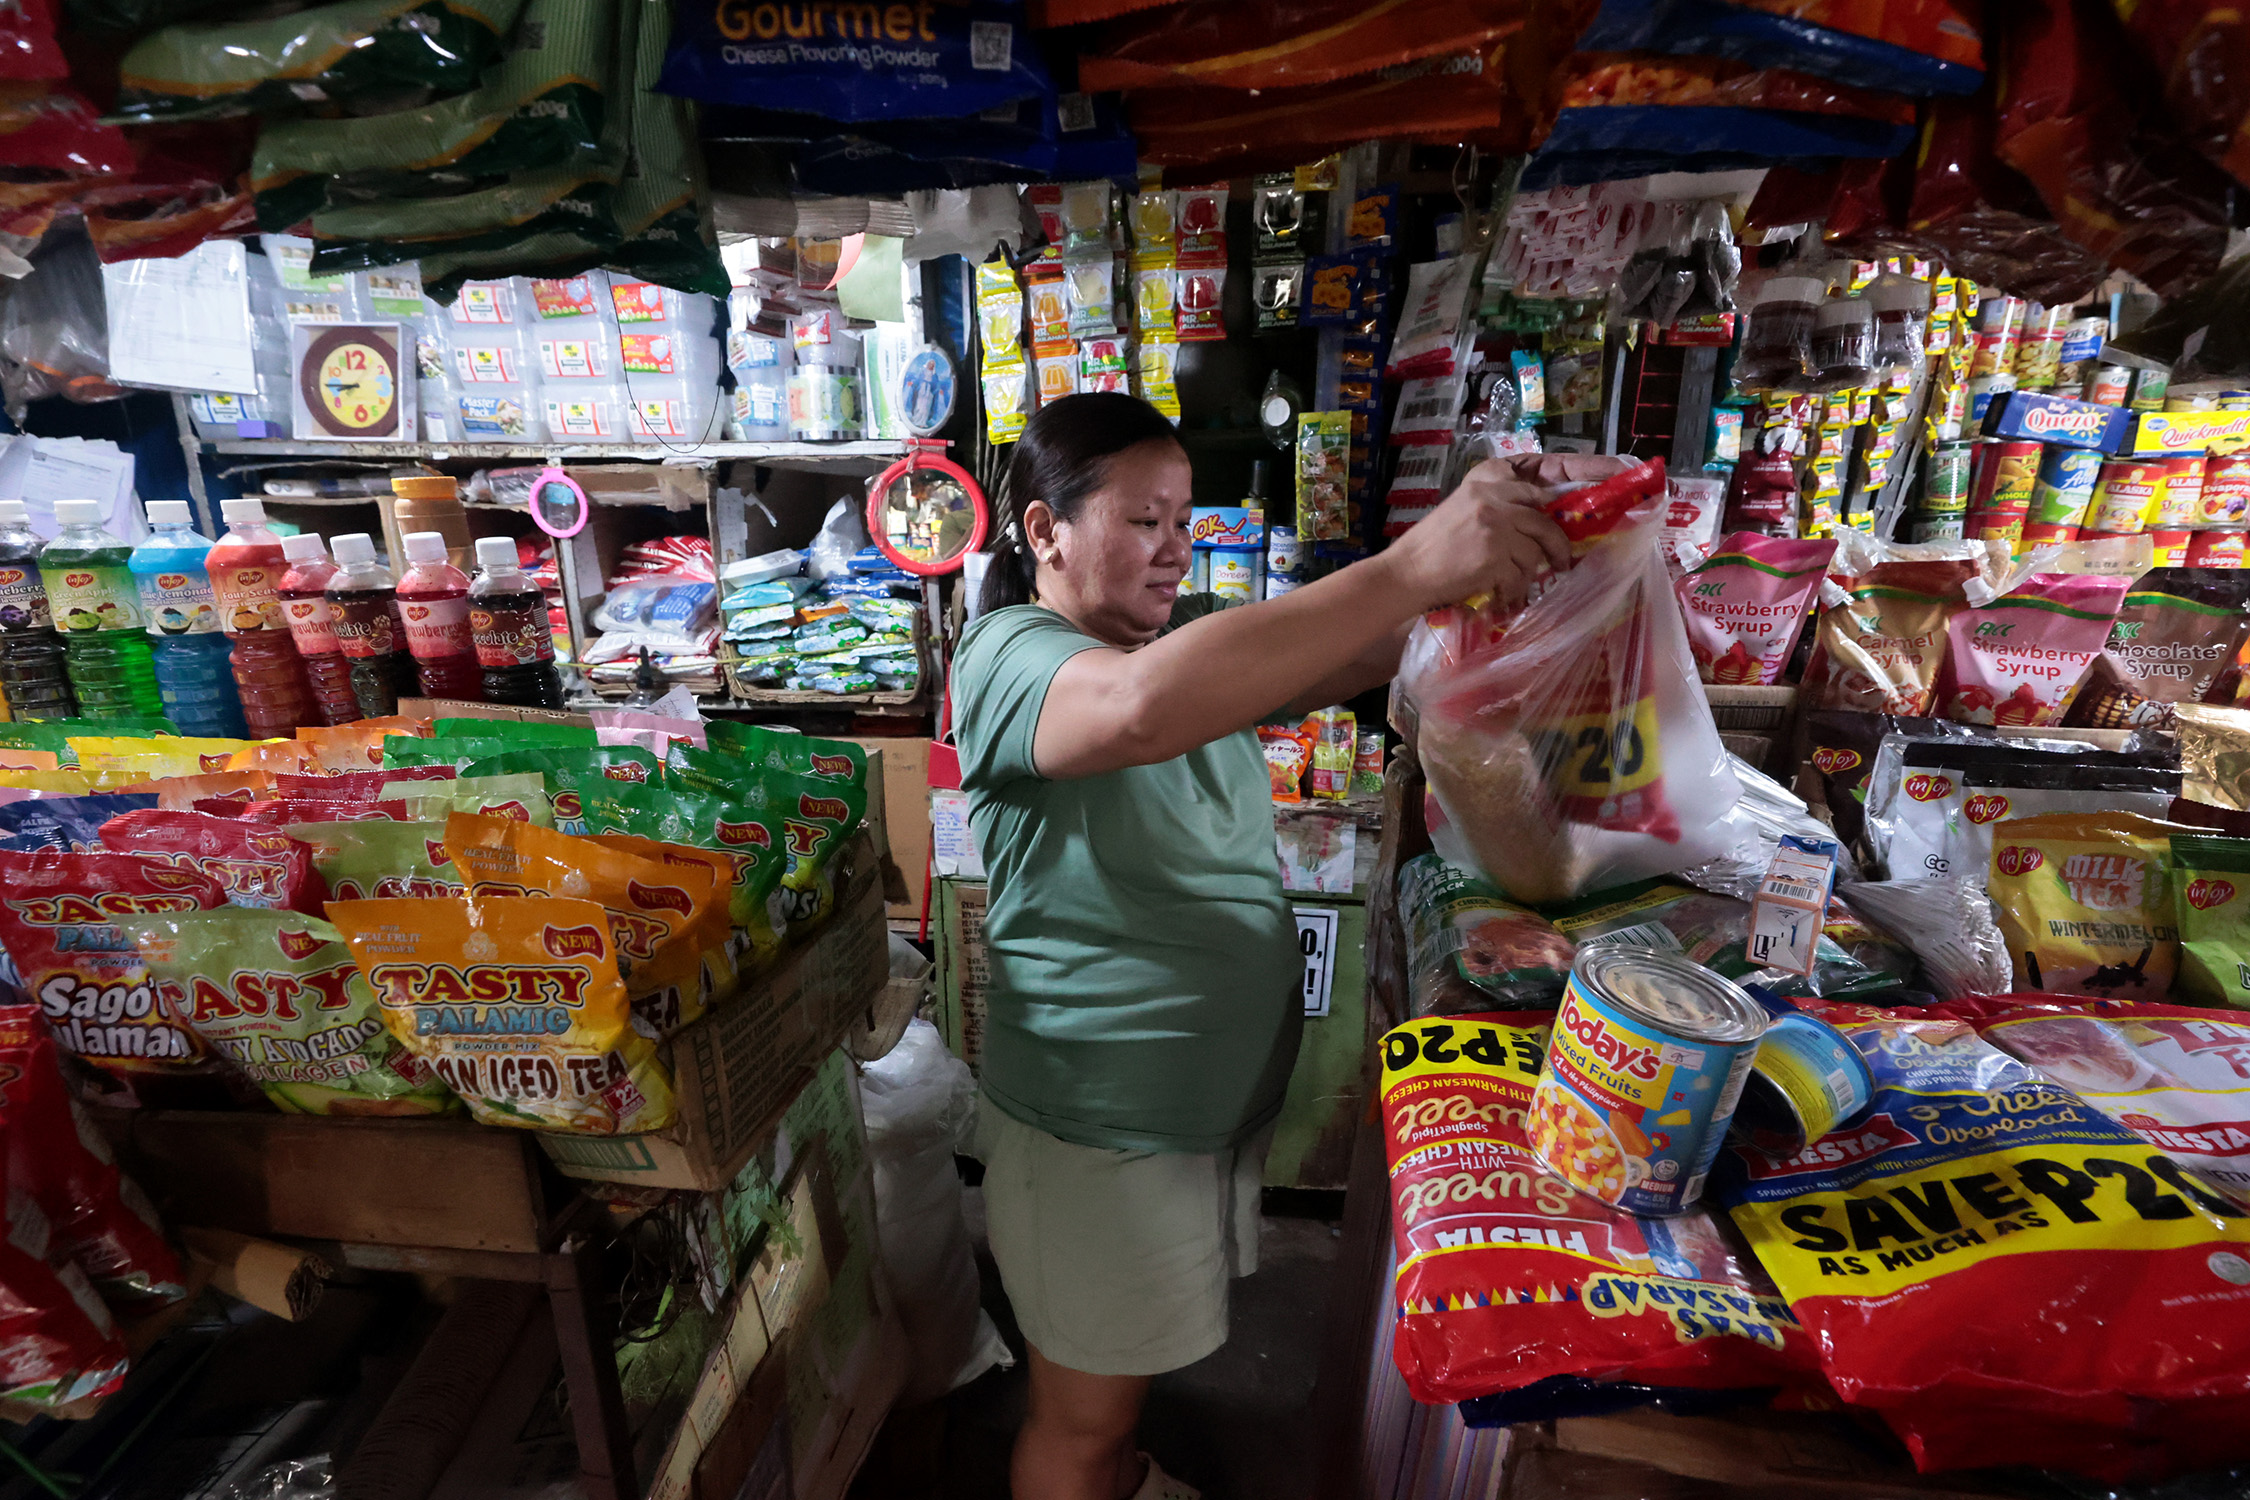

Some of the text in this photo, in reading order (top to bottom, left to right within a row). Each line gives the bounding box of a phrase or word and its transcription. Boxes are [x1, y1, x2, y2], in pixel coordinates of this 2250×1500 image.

[715, 0, 937, 42] Gourmet
[722, 44, 941, 71] Cheese Flavoring Powder
[1181, 313, 1200, 324] MR.
[345, 349, 367, 371] 12
[377, 364, 385, 376] 2
[375, 374, 392, 398] 3
[354, 404, 369, 423] 6
[462, 397, 497, 409] Master
[468, 406, 491, 418] Pack
[1714, 412, 1742, 427] Eden
[2025, 407, 2101, 432] Quezo
[2161, 416, 2250, 447] Quickmelt!
[1685, 489, 1711, 501] MOTO
[2110, 483, 2154, 495] ALASKA
[1215, 568, 1251, 580] Doreen
[0, 584, 46, 598] ueberry
[157, 586, 214, 600] Lemonad
[248, 586, 279, 599] Seas
[1691, 595, 1802, 620] Strawberry
[292, 620, 332, 636] rawber
[1714, 615, 1773, 637] Syrup
[473, 629, 519, 646] ocolate
[1856, 632, 1935, 649] Caramel
[1871, 650, 1924, 669] Syrup
[1971, 636, 2091, 667] Strawberry
[2103, 641, 2219, 661] Chocolate
[1996, 657, 2062, 681] Syrup
[2127, 659, 2193, 681] Syrup
[819, 758, 848, 772] NEW!
[806, 801, 841, 816] NEW!
[724, 827, 763, 841] NEW!
[463, 847, 499, 861] REAL
[471, 860, 526, 875] POWDER
[2064, 853, 2146, 881] MILK
[638, 889, 682, 908] NEW!
[386, 932, 422, 943] FRUIT
[2048, 919, 2180, 942] WINTERMELON
[365, 943, 417, 955] POWDER
[556, 934, 597, 950] NEW!
[370, 962, 591, 1008] TASTY
[414, 1006, 573, 1037] PALAMIG
[53, 1018, 200, 1060] ulaman
[260, 1016, 385, 1064] AVOCADO
[1557, 986, 1663, 1081] Today's
[454, 1041, 541, 1051] POWDER MIX
[1554, 1030, 1588, 1069] Mixed
[1588, 1062, 1643, 1099] Fruits
[486, 1054, 562, 1104] ICED
[563, 1049, 629, 1100] TEA
[1567, 1071, 1580, 1083] the
[615, 1085, 639, 1106] 22
[1388, 1077, 1532, 1106] ITH PARMESAN CHEESE
[1905, 1082, 2088, 1123] 3-Chees
[1392, 1094, 1527, 1144] weet
[1924, 1107, 2087, 1146] Overload
[1412, 1120, 1489, 1144] SpaghetTipid
[2142, 1125, 2250, 1152] FIESTA
[1460, 1156, 1506, 1169] WITH
[1756, 1181, 1816, 1199] SPAGHETTI
[1816, 1177, 1841, 1191] AND
[1840, 1166, 1874, 1186] SAUCE
[1872, 1160, 1904, 1173] WITH
[2051, 1130, 2117, 1141] PARMESAN
[1640, 1179, 1677, 1194] MEDIUM
[1399, 1171, 1577, 1226] Sweet
[1780, 1172, 2033, 1254] SAVE
[1435, 1225, 1591, 1257] FIESTA
[1817, 1211, 2050, 1277] AS MUCH AS
